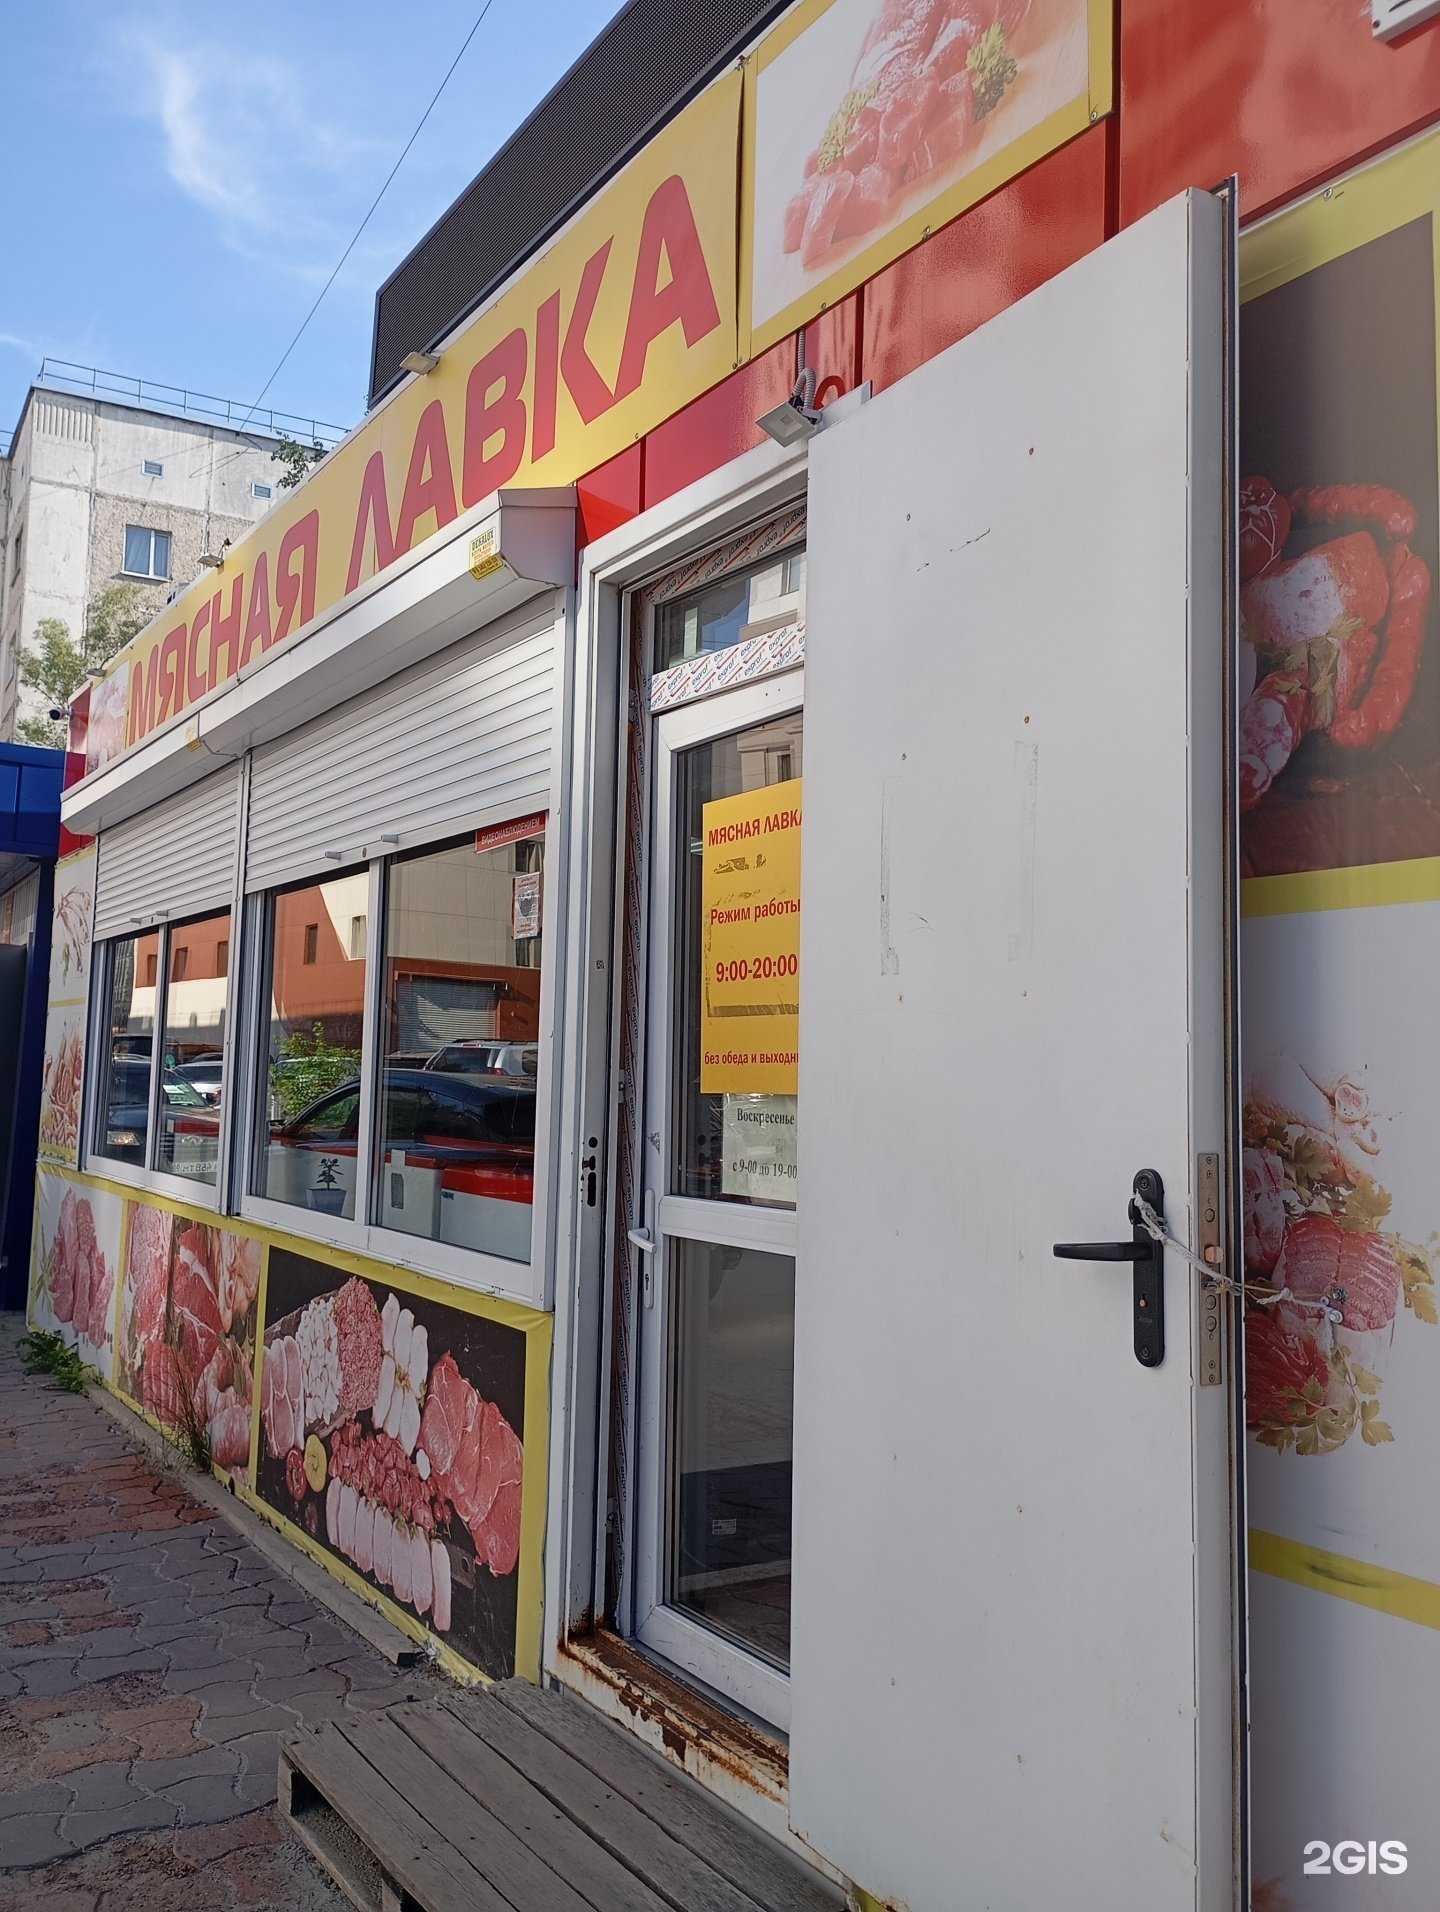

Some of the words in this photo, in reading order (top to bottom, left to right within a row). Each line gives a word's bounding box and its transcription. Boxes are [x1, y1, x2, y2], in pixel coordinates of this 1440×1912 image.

[127, 509, 320, 746] МЯСНАЯ
[345, 174, 722, 596] ЛАВКА
[708, 818, 760, 847] МЯСНАЯ
[763, 808, 802, 834] ЛАВК
[711, 901, 751, 925] Режим
[754, 897, 801, 923] работы
[716, 953, 798, 983] 9:00-20:00
[704, 1051, 720, 1065] без
[722, 1050, 748, 1065] обеда
[751, 1052, 757, 1063] и
[759, 1048, 799, 1064] выходн
[736, 1107, 795, 1126] Воскресенье
[732, 1162, 738, 1172] с
[739, 1158, 757, 1175] 9-00
[759, 1164, 770, 1177] до
[773, 1162, 798, 1180] 19-00
